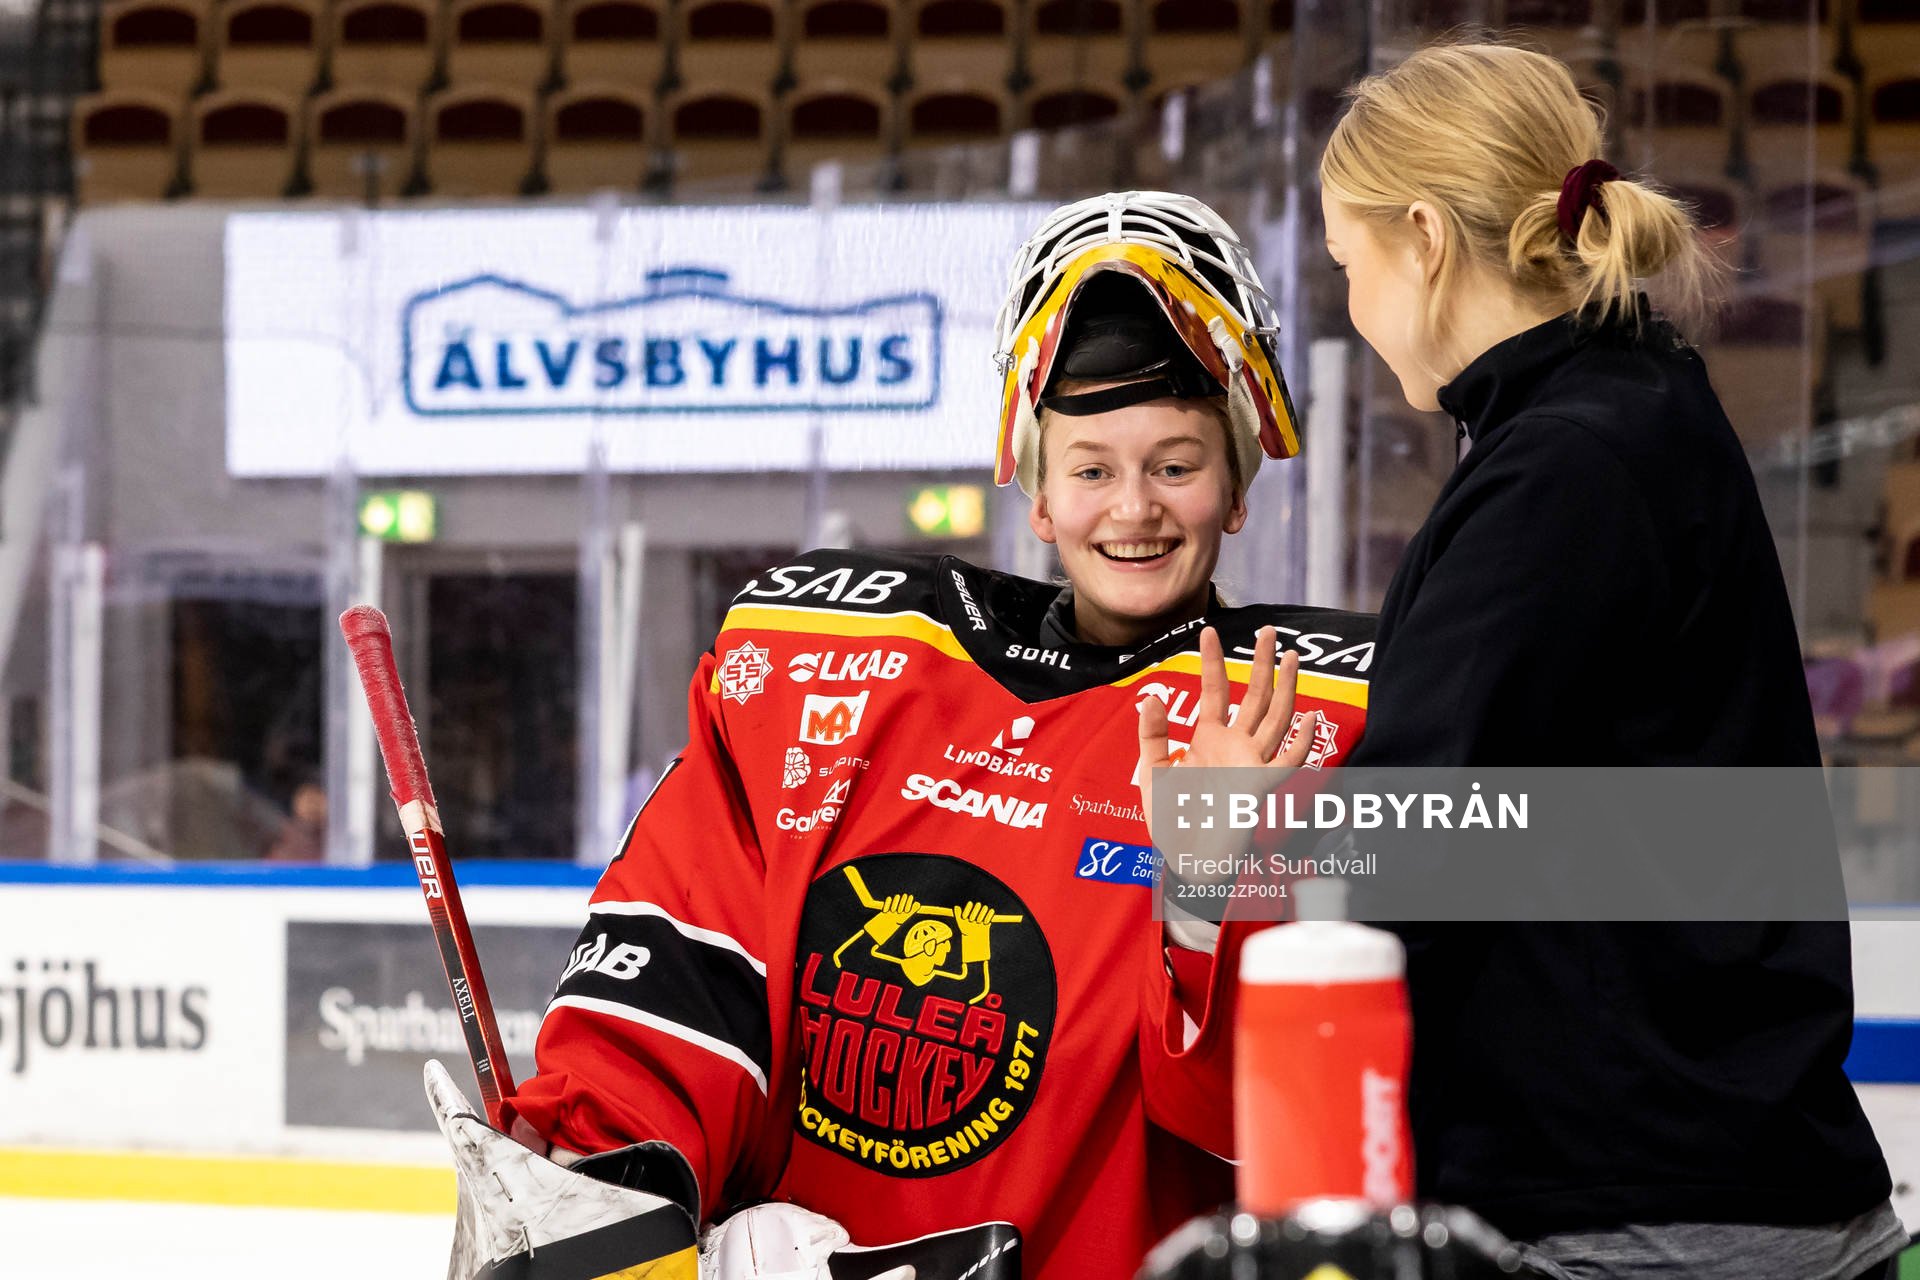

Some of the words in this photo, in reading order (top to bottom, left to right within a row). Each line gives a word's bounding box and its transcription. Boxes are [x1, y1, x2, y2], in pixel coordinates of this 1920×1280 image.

[432, 320, 915, 390] ÄLVSBYHUS
[951, 569, 987, 631] BAUER
[818, 649, 908, 681] LKAB
[943, 744, 1053, 783] LINDBÄCKS
[900, 773, 1048, 829] SCANIA
[0, 958, 210, 1074] jöhus
[453, 977, 475, 1022] AXELL
[800, 952, 1007, 1054] LULEÅ
[799, 1005, 996, 1131] HOCKEY
[1005, 1020, 1040, 1092] 1977
